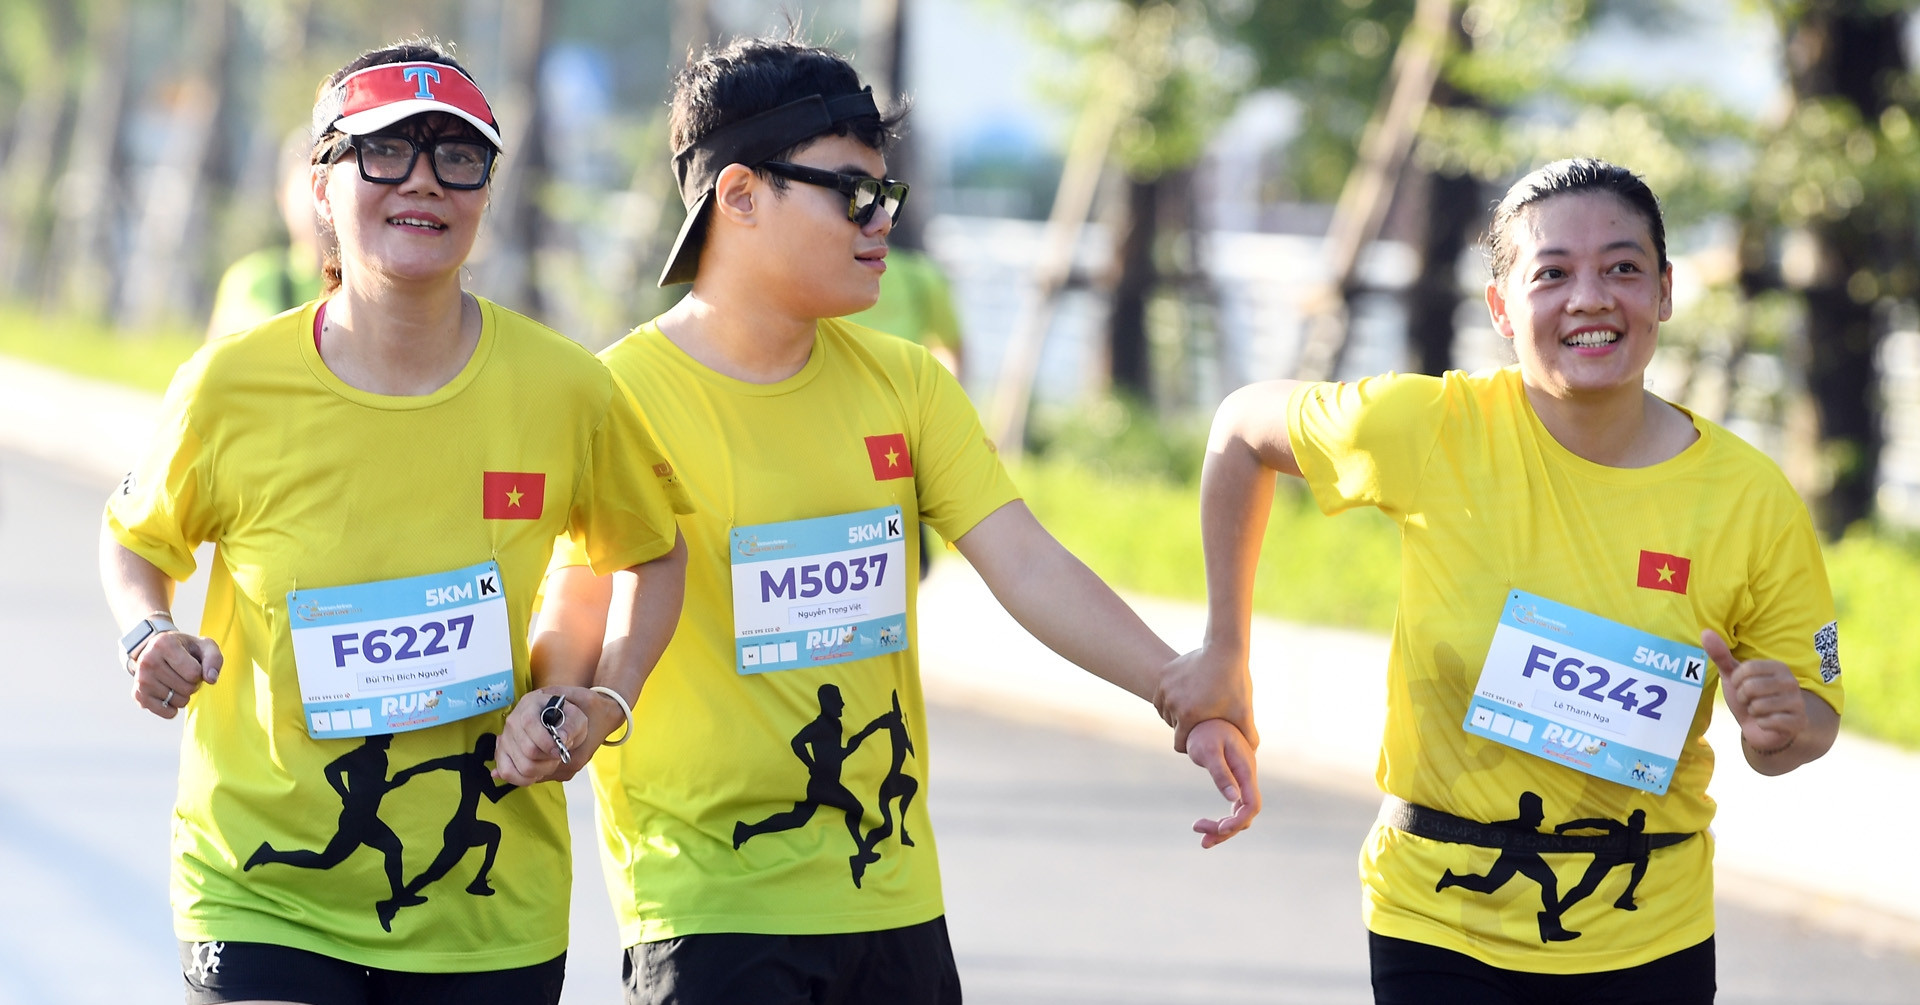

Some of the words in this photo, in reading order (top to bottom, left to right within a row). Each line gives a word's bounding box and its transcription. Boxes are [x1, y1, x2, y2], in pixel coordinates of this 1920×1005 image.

[403, 67, 441, 100] T
[848, 521, 883, 544] 5KM
[888, 518, 900, 537] K
[425, 581, 473, 607] 5KM
[480, 576, 498, 596] K
[760, 552, 888, 603] M5037
[828, 606, 848, 614] Trọng
[331, 614, 475, 668] F6227
[806, 626, 853, 650] RUN
[1632, 645, 1681, 674] 5KM
[1685, 660, 1701, 681] K
[1522, 644, 1668, 721] F6242
[381, 690, 437, 717] RUN
[1553, 700, 1564, 709] Lê
[1566, 704, 1591, 718] Thanh
[1593, 713, 1610, 724] Nga
[1541, 722, 1601, 753] RUN
